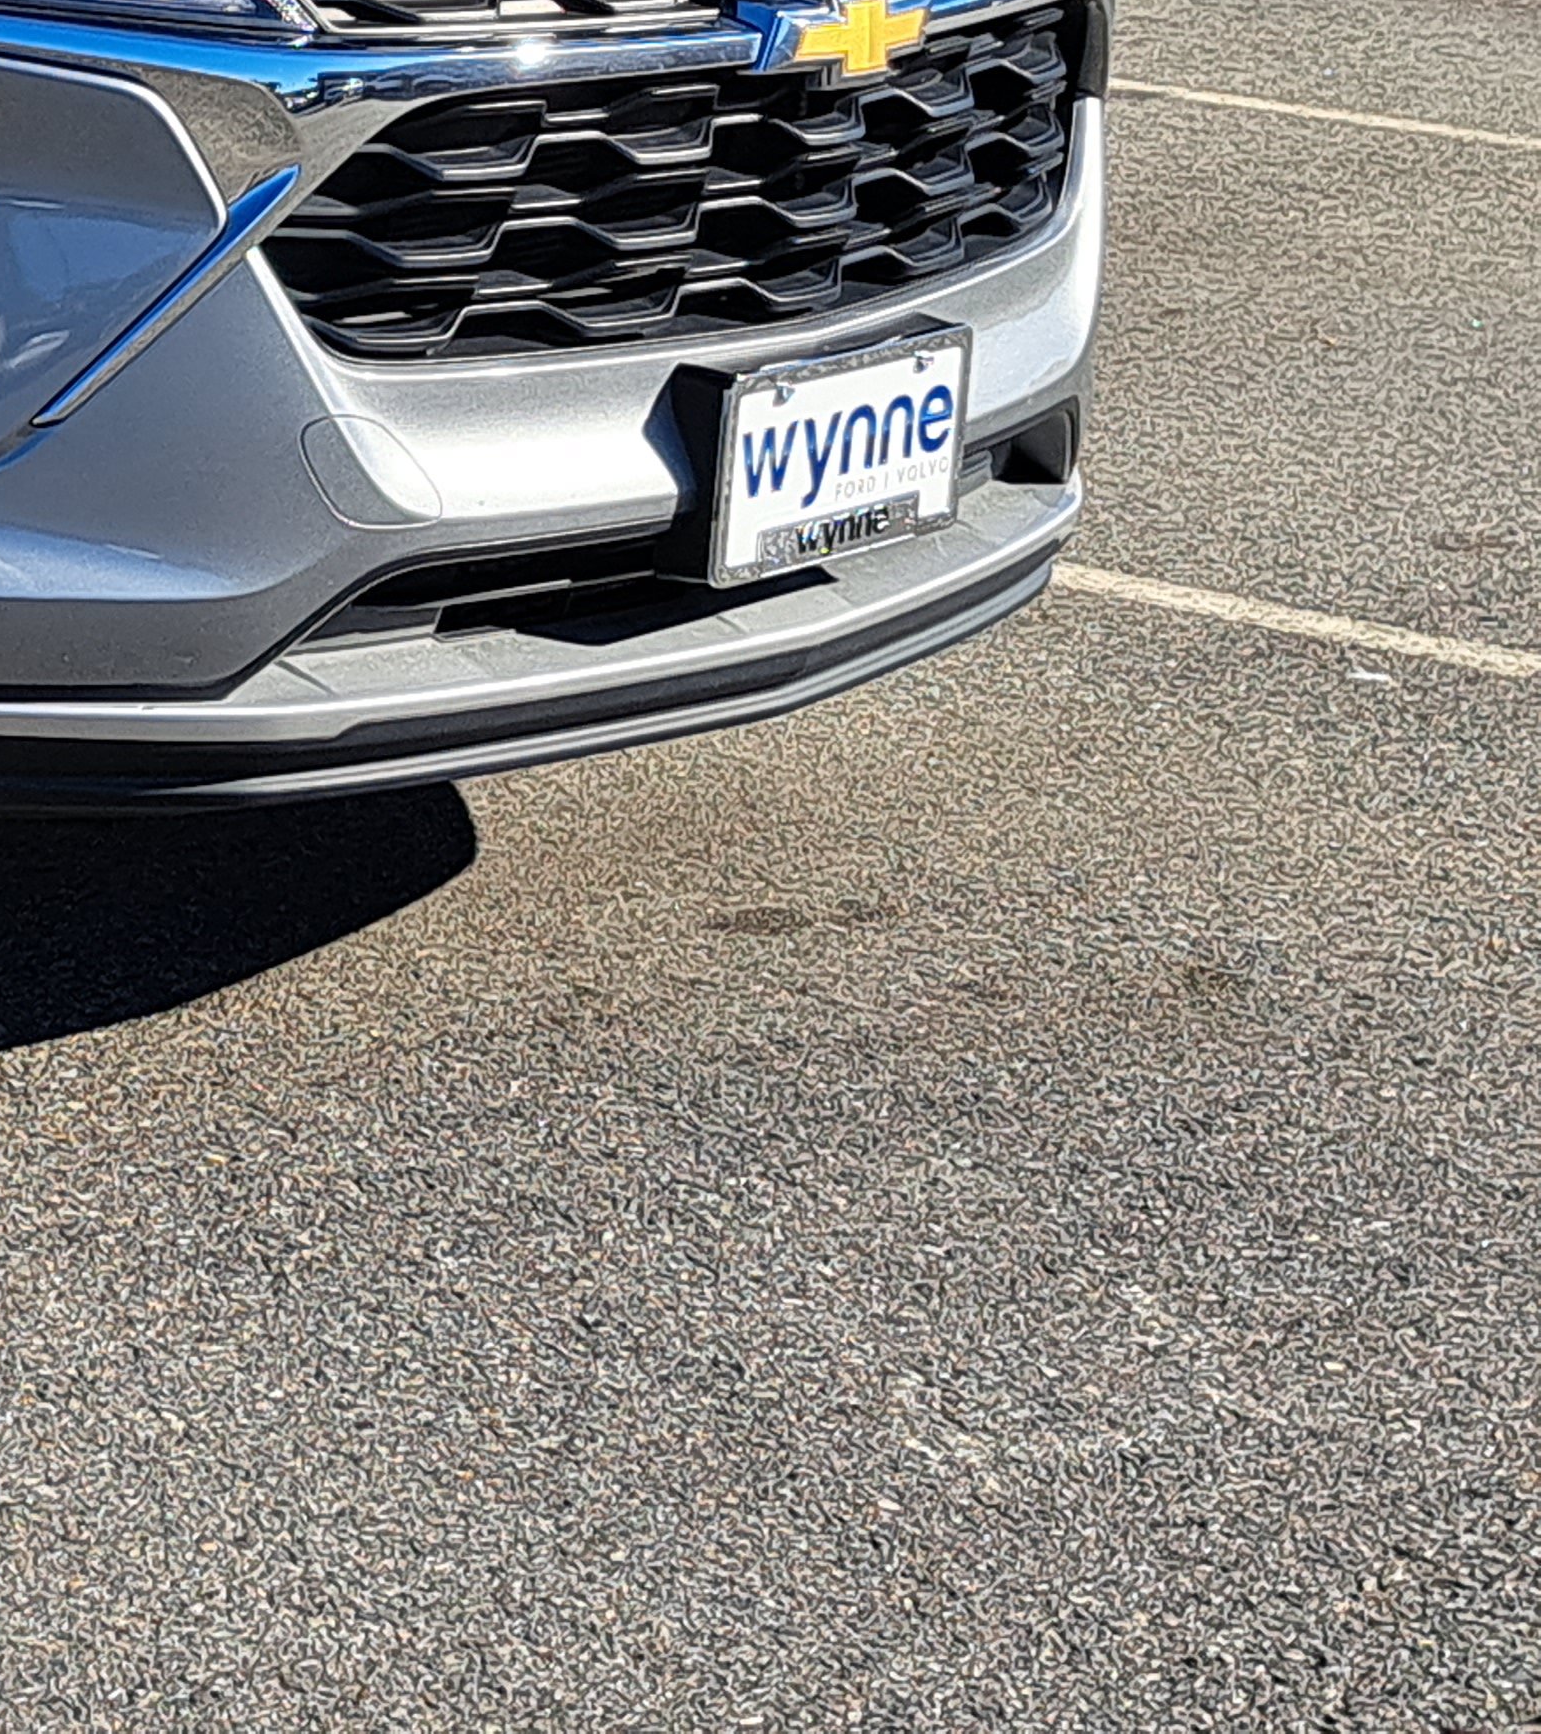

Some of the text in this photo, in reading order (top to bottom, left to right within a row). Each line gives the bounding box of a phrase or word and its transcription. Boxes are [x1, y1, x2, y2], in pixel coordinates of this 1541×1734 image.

[742, 383, 954, 510] wynne
[834, 474, 877, 501] FORD
[896, 455, 950, 484] VOLVO
[794, 504, 891, 555] wynne
